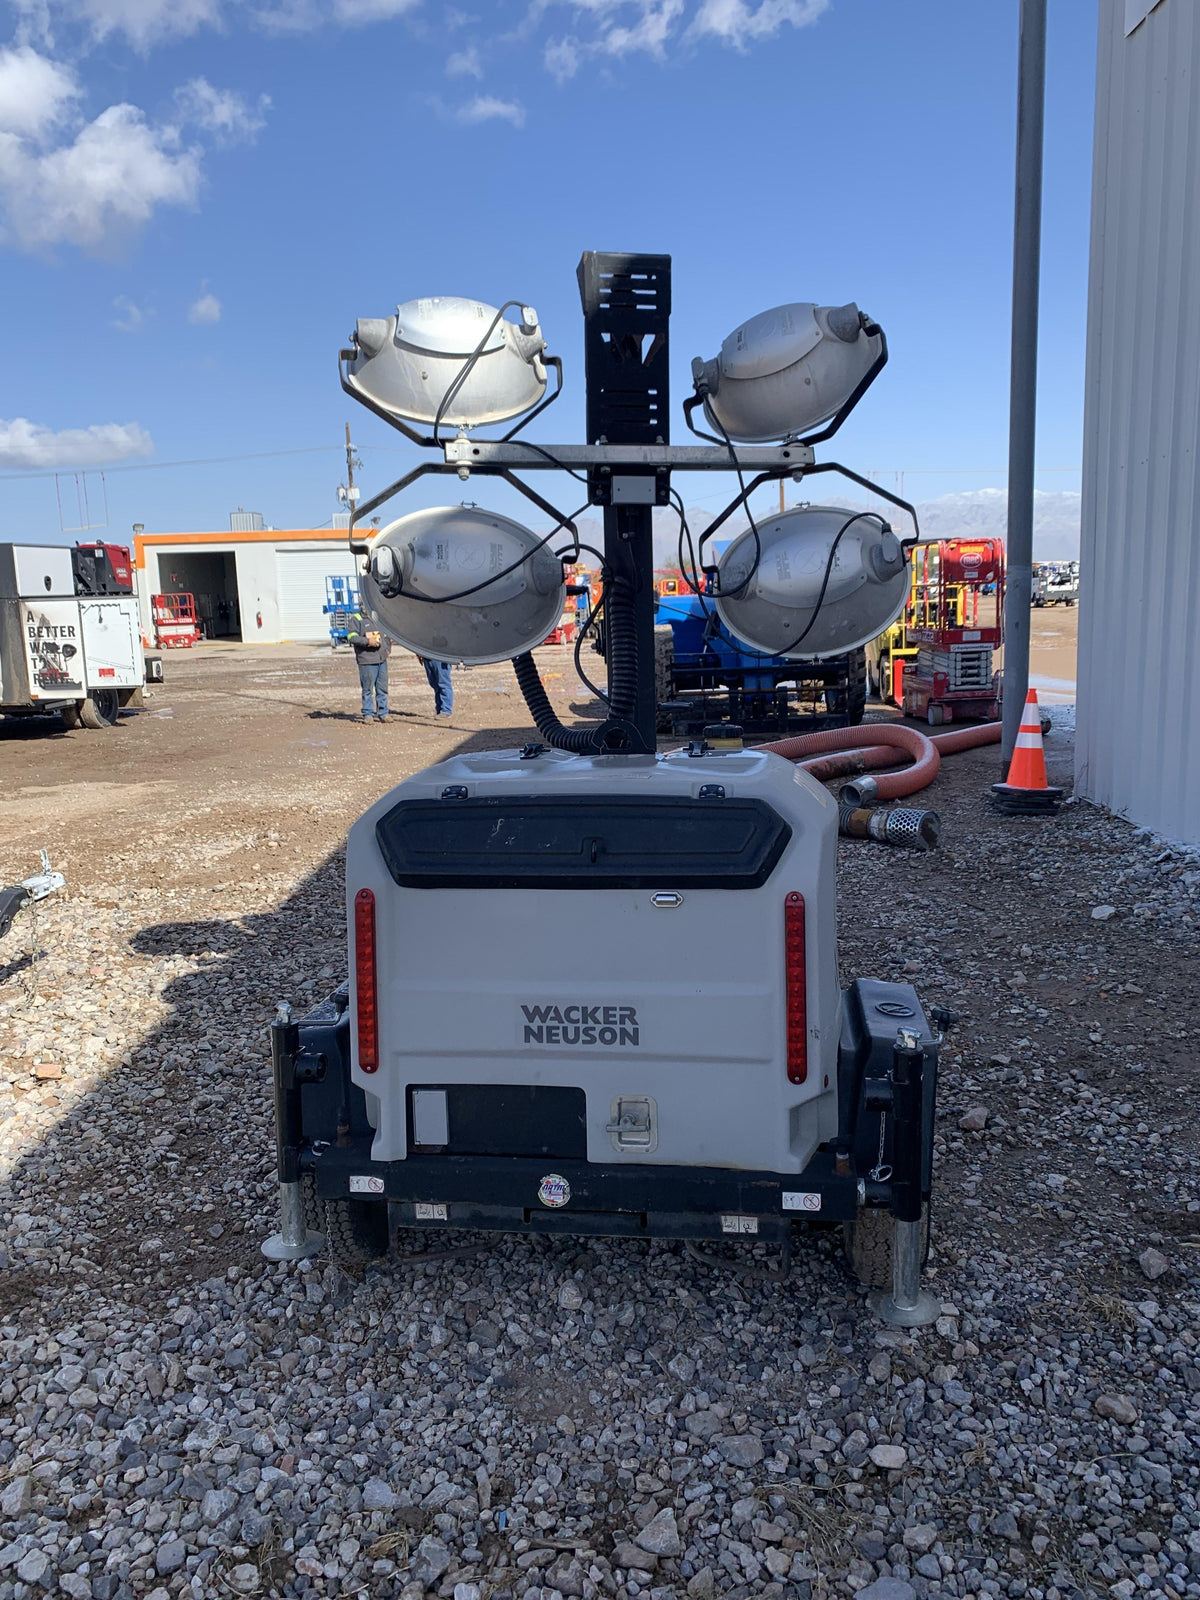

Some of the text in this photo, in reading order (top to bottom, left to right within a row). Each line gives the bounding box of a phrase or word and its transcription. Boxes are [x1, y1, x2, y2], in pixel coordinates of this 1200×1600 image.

[27, 611, 34, 622] A
[28, 626, 76, 638] BETTER
[520, 1005, 639, 1025] WACKER
[524, 1025, 640, 1046] NEUSON
